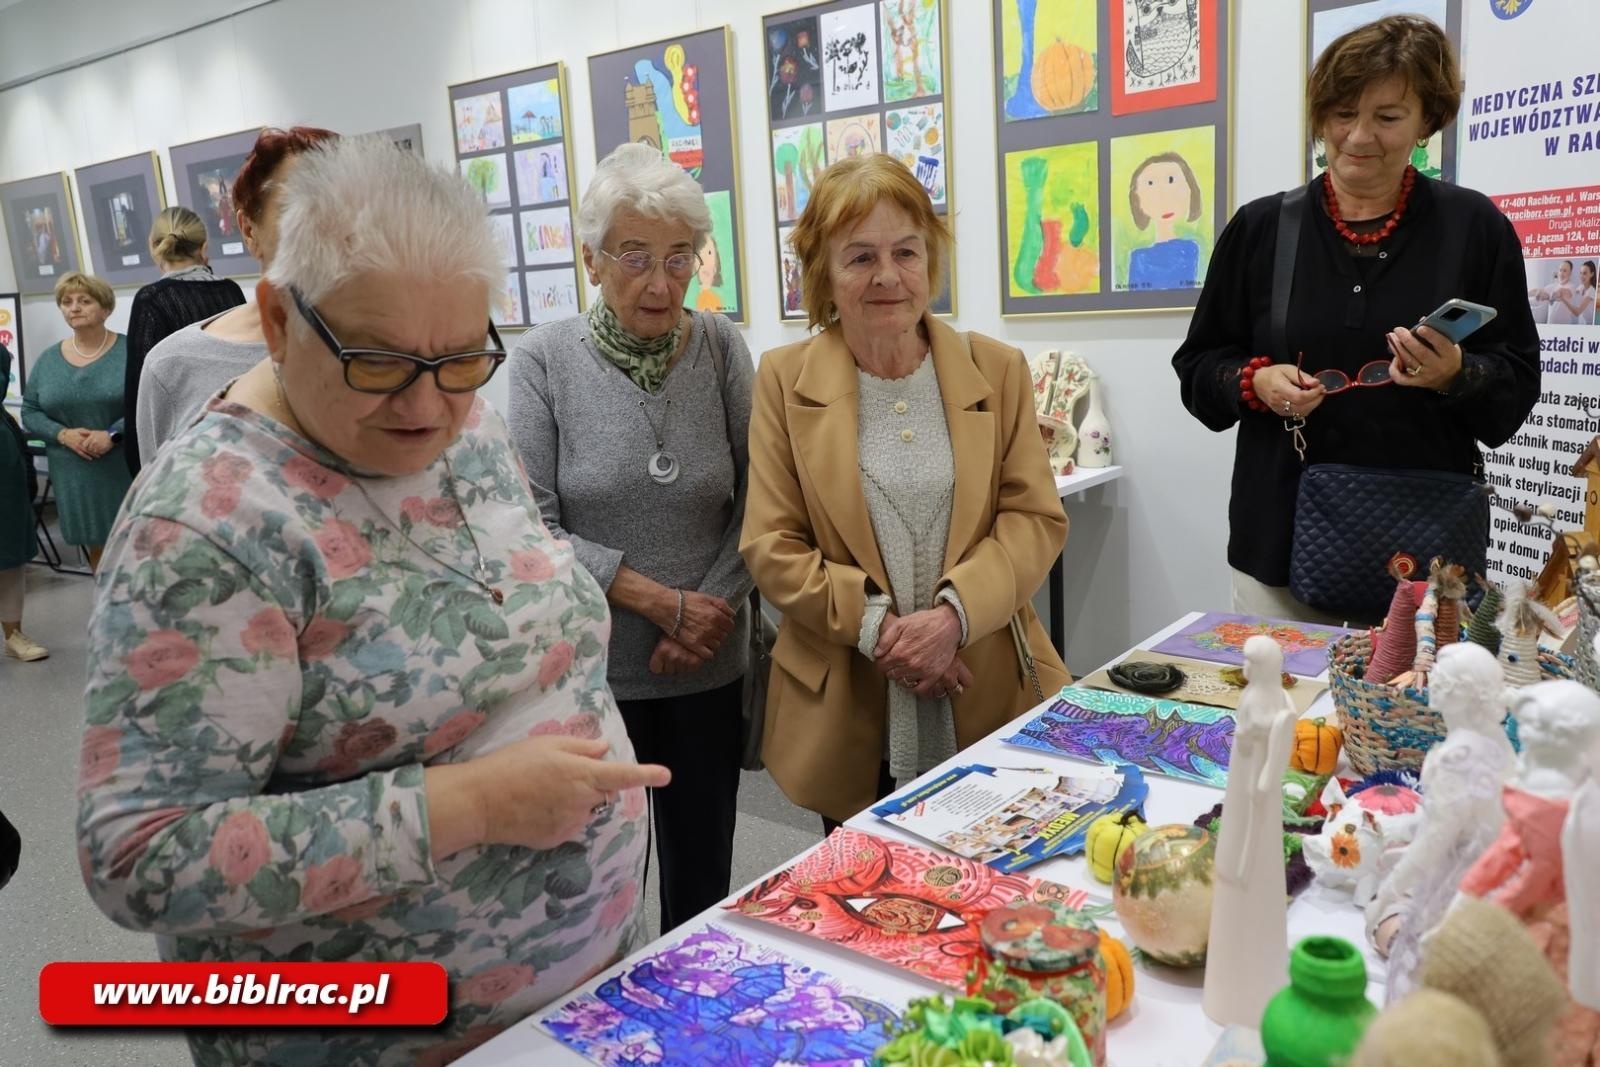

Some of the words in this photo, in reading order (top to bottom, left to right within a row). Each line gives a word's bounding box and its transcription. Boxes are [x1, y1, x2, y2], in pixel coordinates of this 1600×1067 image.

[1472, 80, 1563, 116] MEDYCZNA
[1545, 136, 1560, 156] W
[1500, 197, 1526, 209] 47-400
[1528, 193, 1563, 206] Racibórz,
[1566, 193, 1577, 203] ul.
[1549, 219, 1572, 231] Druga
[1525, 234, 1535, 243] ul.
[1537, 233, 1564, 245] Łączna
[1567, 232, 1585, 242] 12A,
[1545, 245, 1573, 256] e-mail:
[1519, 456, 1550, 476] usług
[1515, 478, 1581, 503] sterylizacji
[1494, 518, 1552, 540] opiekunka
[1497, 541, 1507, 551] w
[1509, 541, 1540, 560] domu
